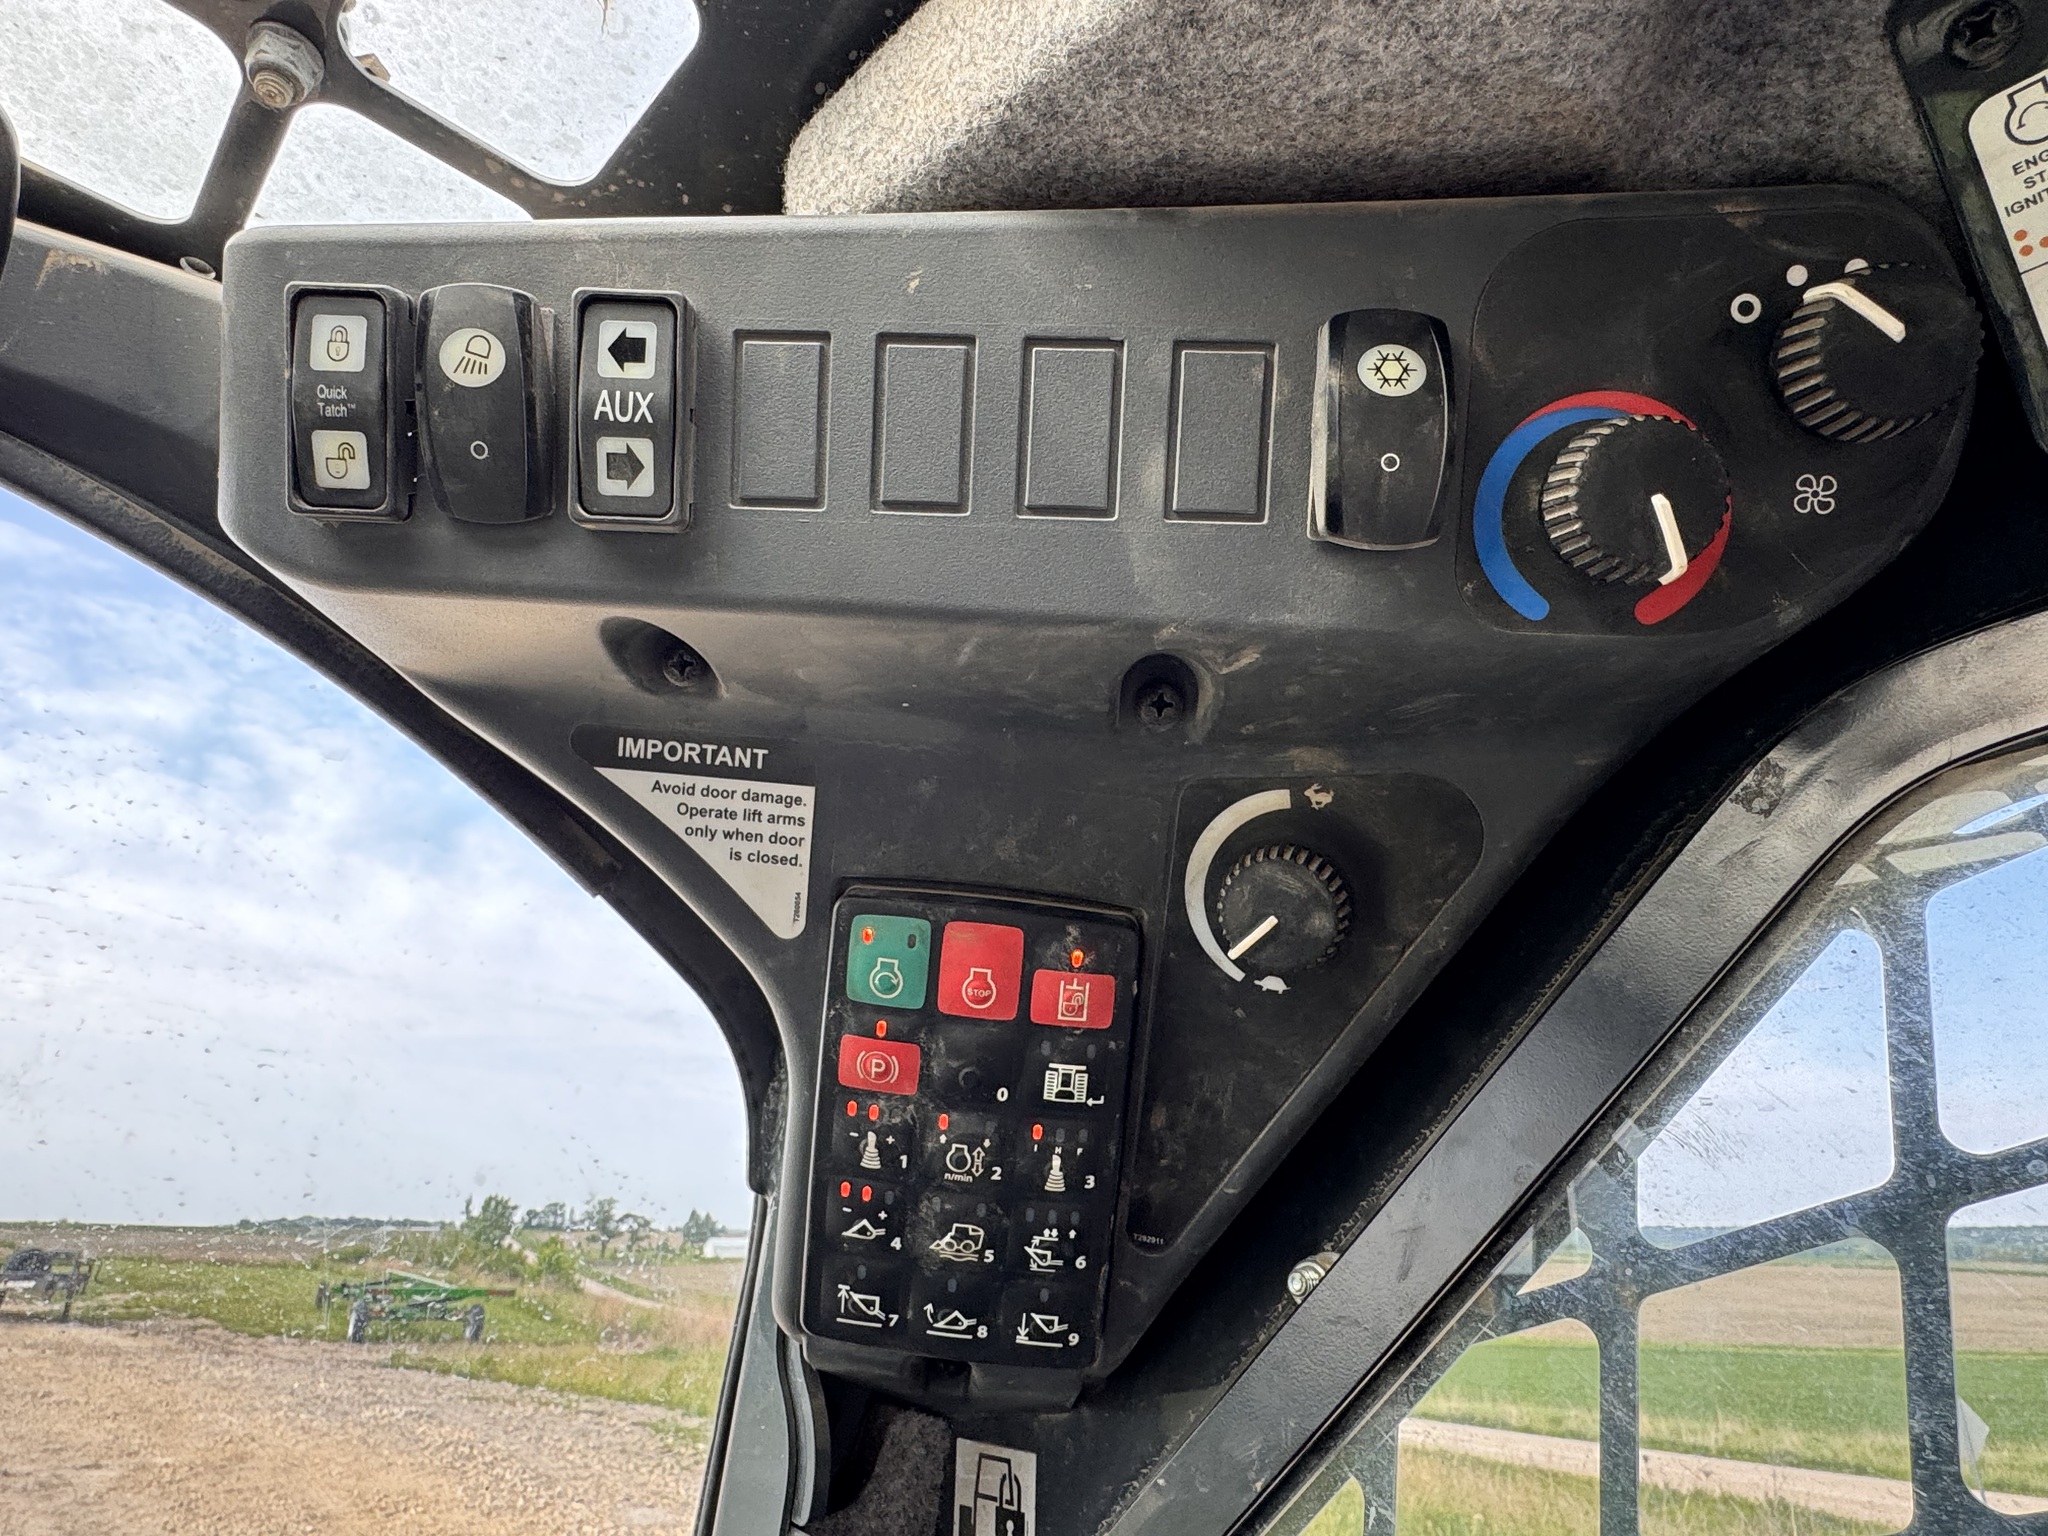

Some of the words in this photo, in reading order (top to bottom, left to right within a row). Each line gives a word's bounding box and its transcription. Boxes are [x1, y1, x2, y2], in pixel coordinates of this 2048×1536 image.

[2023, 169, 2048, 189] ST
[317, 384, 348, 400] Quick
[593, 389, 654, 424] AUX
[617, 737, 768, 769] IMPORTANT
[651, 780, 696, 796] Avoid
[700, 784, 737, 801] door
[741, 788, 807, 808] damage.
[676, 802, 738, 820] Operate
[743, 808, 763, 824] lift
[767, 813, 806, 827] arms
[684, 824, 718, 842] only
[722, 828, 764, 844] when
[768, 832, 805, 847] door
[729, 847, 742, 861] is
[747, 849, 803, 868] closed.
[967, 987, 992, 998] STOP
[871, 1059, 886, 1079] P
[996, 1087, 1009, 1102] 0
[899, 1154, 908, 1169] 1
[944, 1172, 974, 1183] n/min
[990, 1166, 1003, 1181] 2
[1084, 1175, 1096, 1189] 3
[890, 1236, 902, 1250] 4
[983, 1250, 995, 1264] 5
[1075, 1256, 1087, 1270] 6
[887, 1314, 900, 1327] 7
[976, 1326, 989, 1340] 8
[1067, 1333, 1080, 1347] 9
